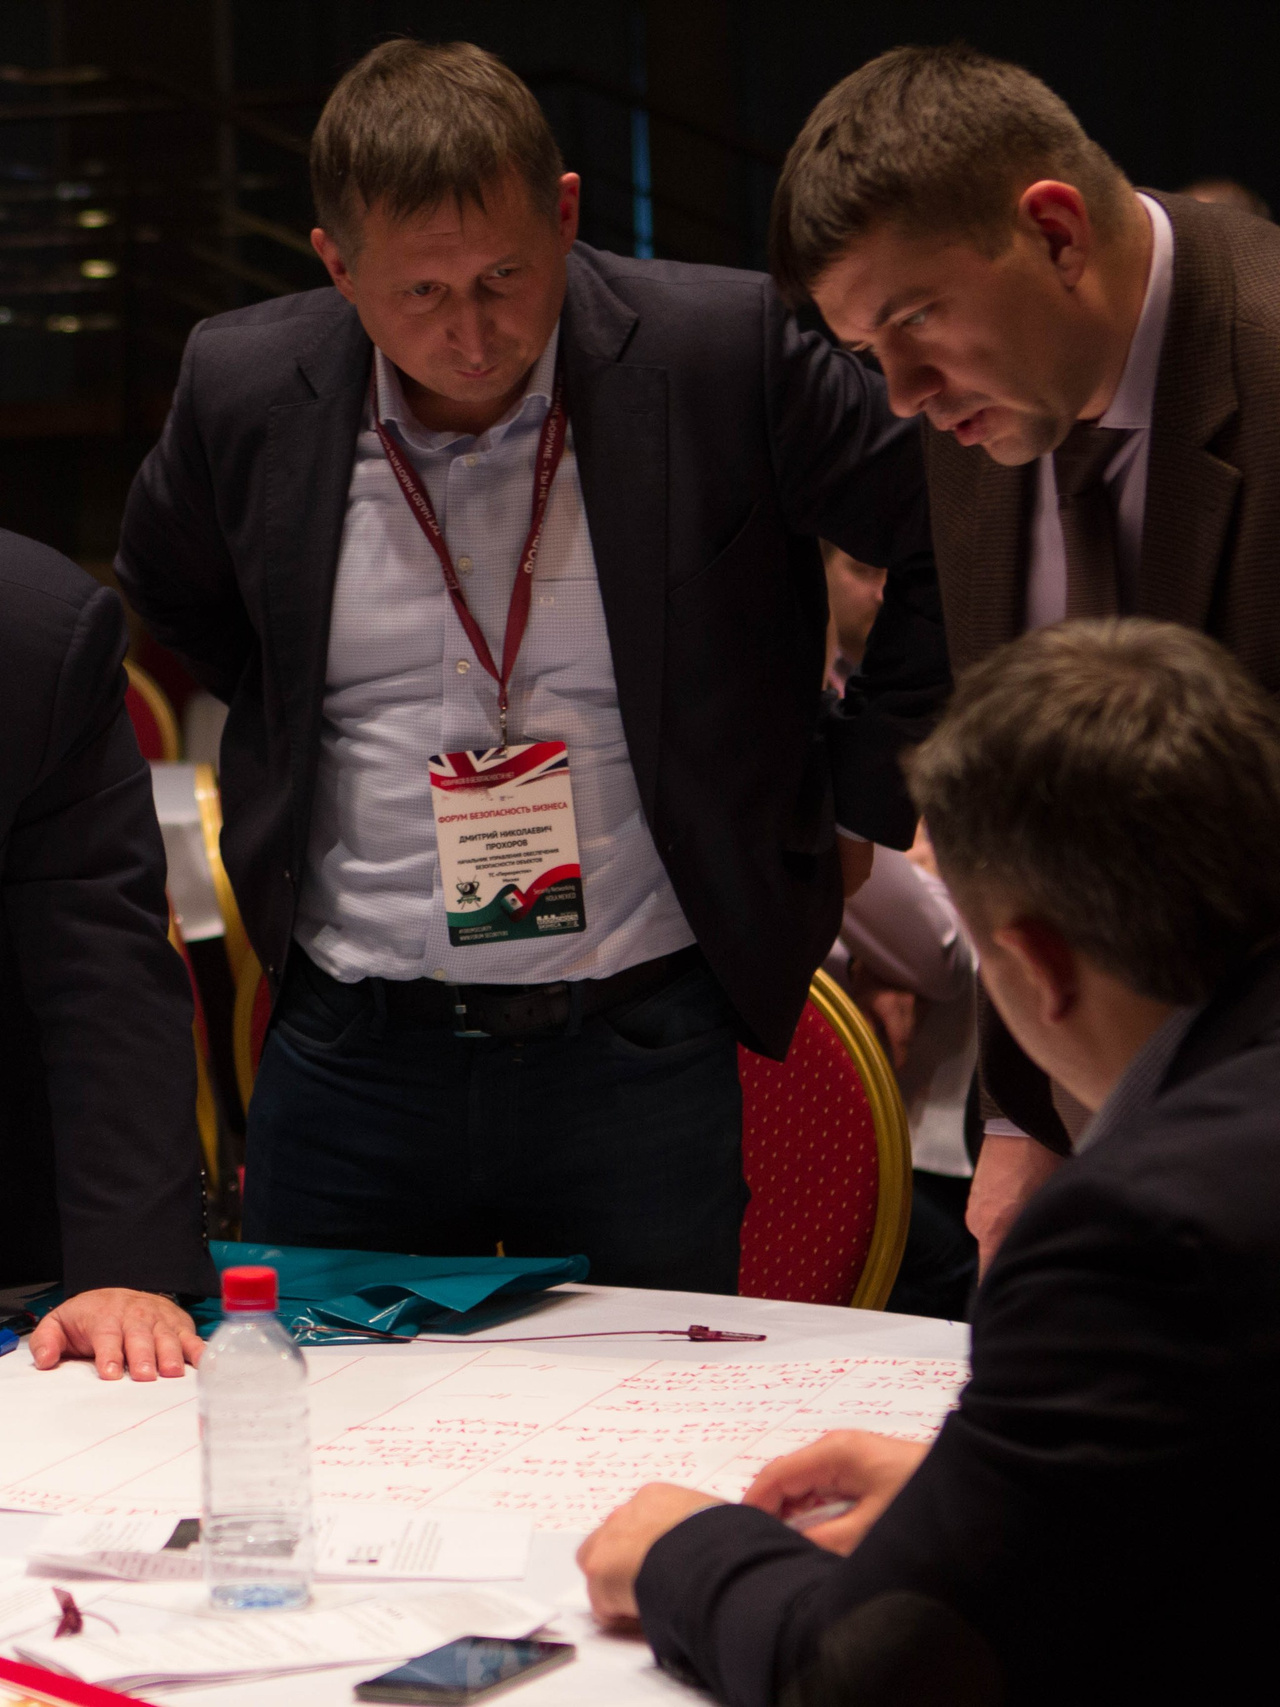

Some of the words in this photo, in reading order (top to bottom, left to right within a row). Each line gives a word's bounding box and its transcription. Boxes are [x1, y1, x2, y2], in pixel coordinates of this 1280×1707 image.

[543, 418, 559, 460] ФОРУМЕ
[389, 450, 416, 493] РАБОТАТЬ
[412, 492, 434, 520] НАДО
[428, 519, 442, 536] ТУТ
[437, 814, 468, 824] ФОРУМ
[470, 807, 531, 820] БЕЗОПАСНОСТЬ
[532, 802, 568, 811] БИЗНЕСА
[459, 832, 498, 843] ДМИТРИЙ
[500, 826, 552, 838] НИКОЛАЕВИЧ
[485, 839, 528, 851] ПРОХОРОВ
